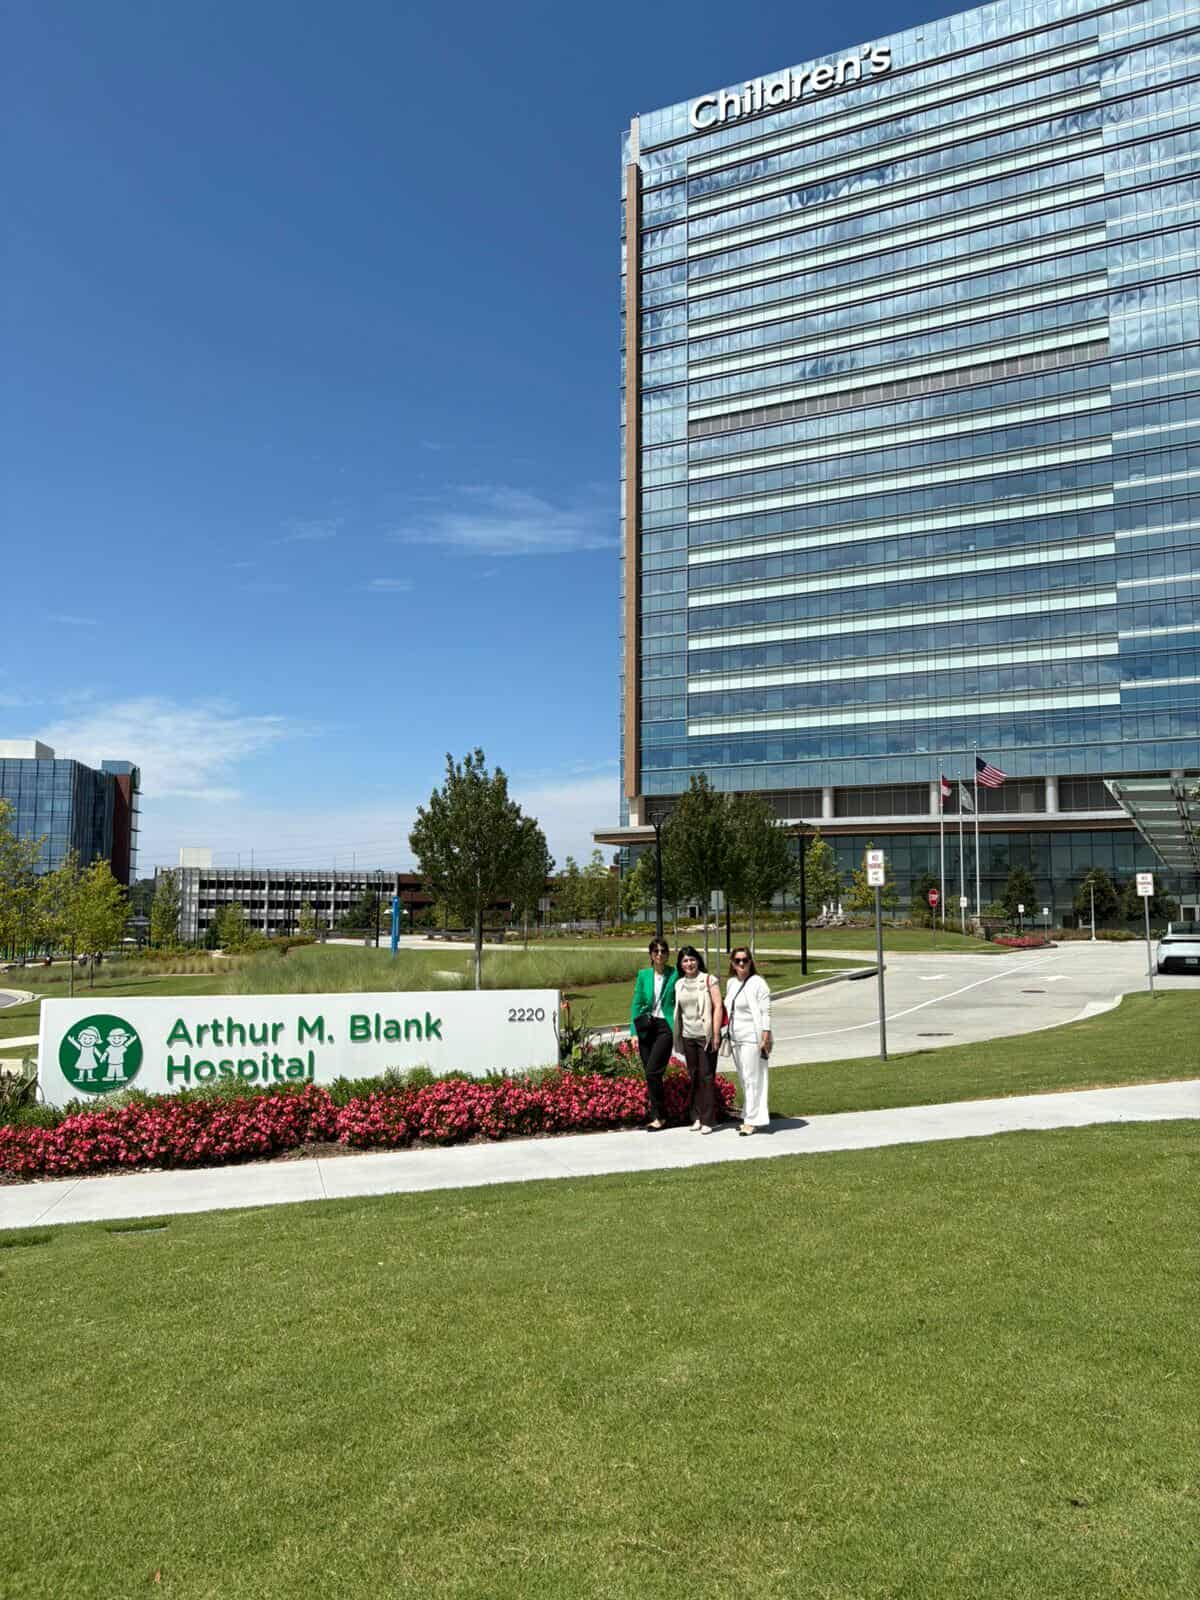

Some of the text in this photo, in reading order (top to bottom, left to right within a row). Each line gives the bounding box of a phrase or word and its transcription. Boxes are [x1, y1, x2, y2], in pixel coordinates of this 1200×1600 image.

[689, 44, 891, 130] Children's
[166, 1011, 443, 1047] Arthur M. Blank
[508, 1008, 545, 1022] 2220
[167, 1050, 315, 1084] Hospital
